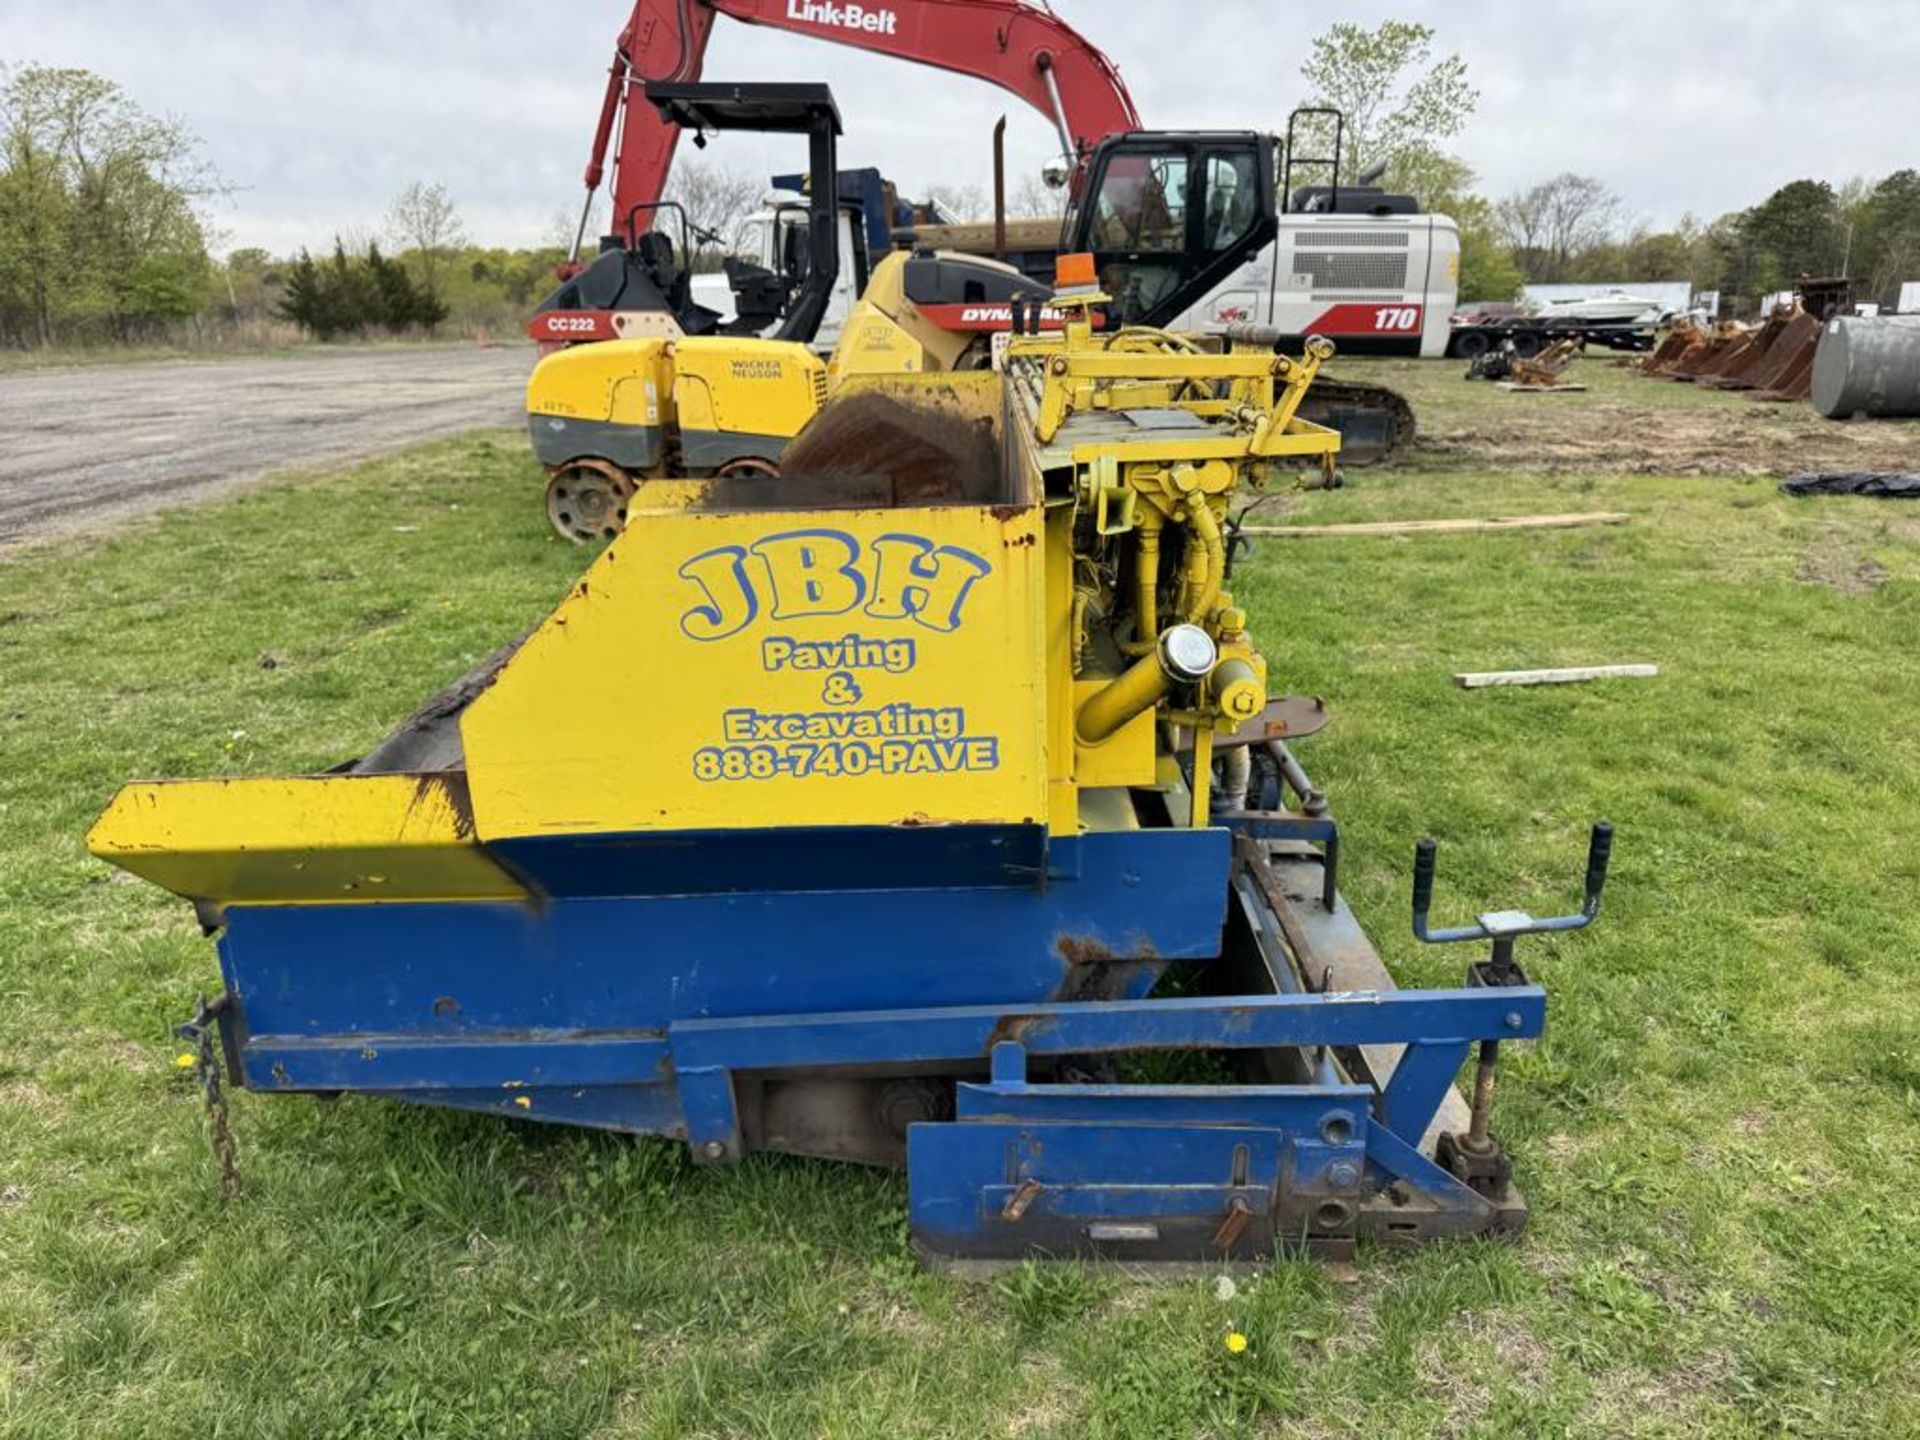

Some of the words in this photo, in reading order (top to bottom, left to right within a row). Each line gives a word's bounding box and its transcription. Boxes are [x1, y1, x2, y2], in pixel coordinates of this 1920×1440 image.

[786, 0, 897, 34] Link-Belt
[547, 317, 568, 331] CC
[569, 317, 596, 331] 222
[1375, 308, 1418, 330] 170
[678, 529, 992, 641] JBH
[762, 634, 915, 673] Paving
[821, 671, 863, 705] &
[724, 703, 964, 742] Excavating
[693, 736, 999, 780] 888-740-PAVE
